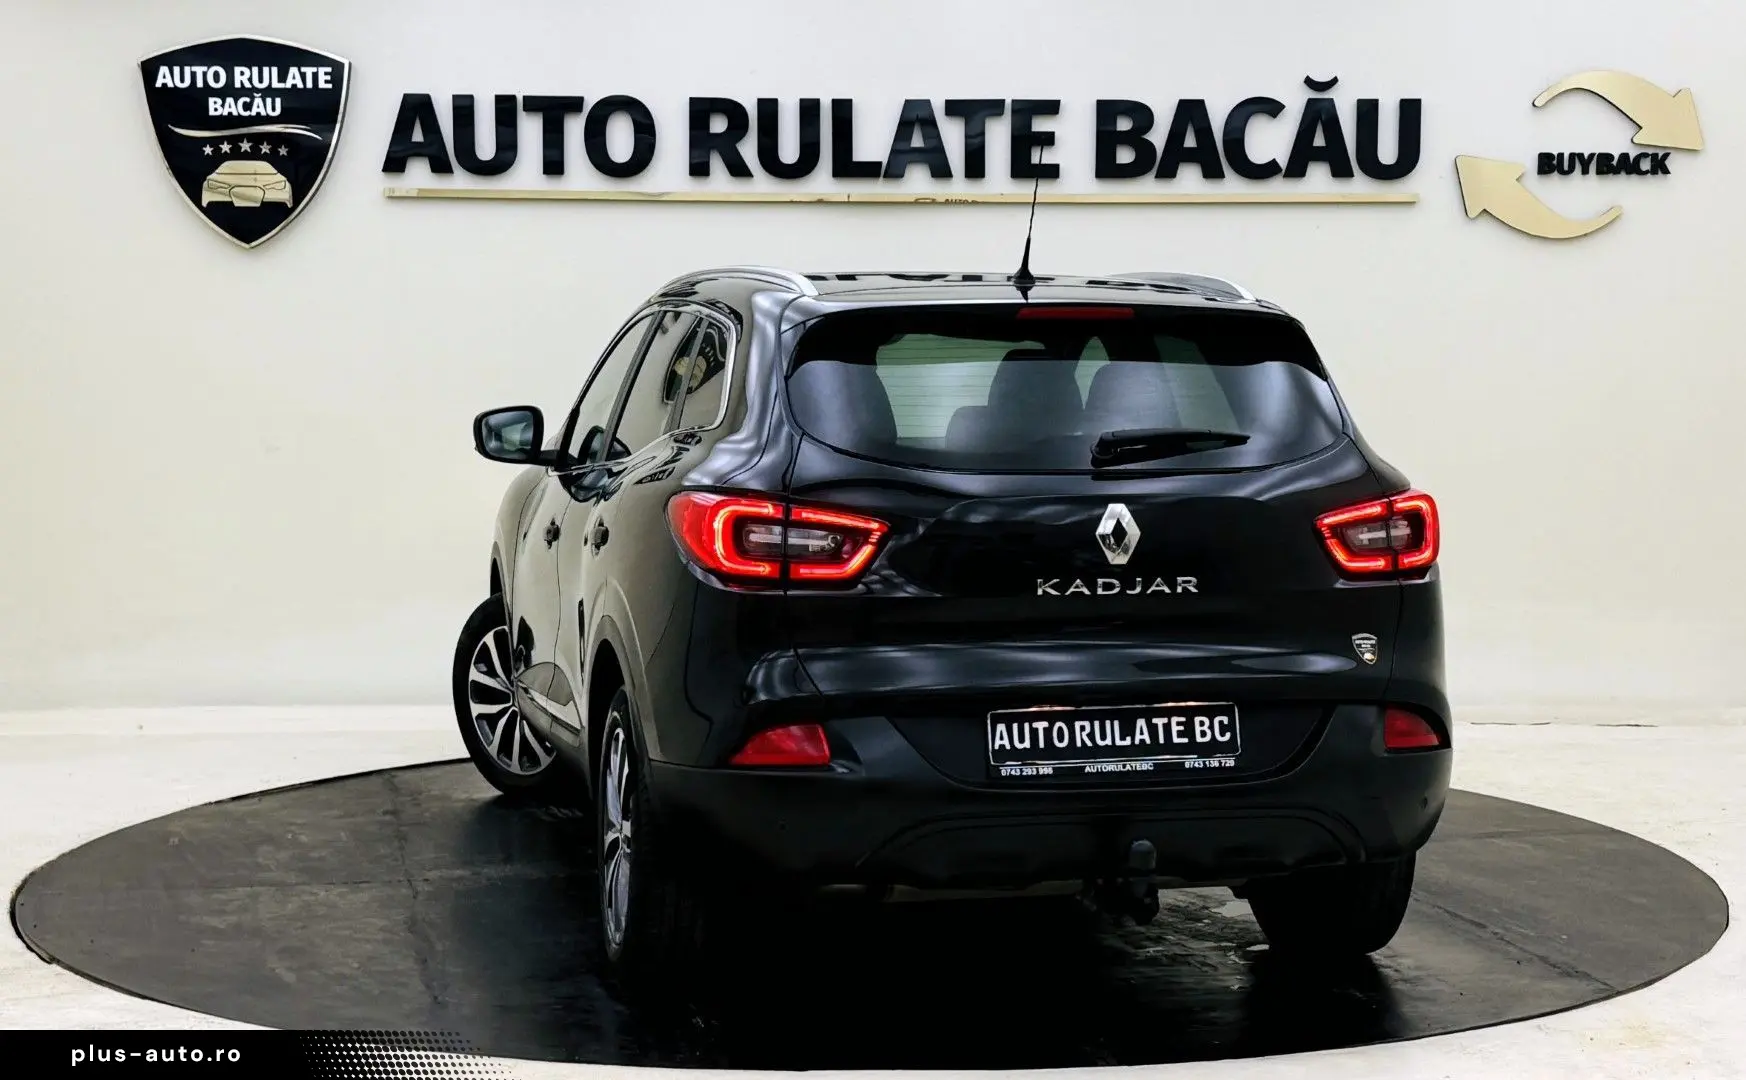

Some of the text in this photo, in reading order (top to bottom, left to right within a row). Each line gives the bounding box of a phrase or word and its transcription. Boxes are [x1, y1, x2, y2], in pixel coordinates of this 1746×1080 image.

[155, 65, 333, 89] AUTO RULATE
[208, 92, 282, 116] BACĂU
[381, 75, 1422, 180] AUTO RULATE BACĂU
[1536, 152, 1671, 176] BUYBACK
[1036, 576, 1199, 596] KADJAR
[1194, 715, 1231, 743] BC
[1184, 760, 1204, 768] 0743
